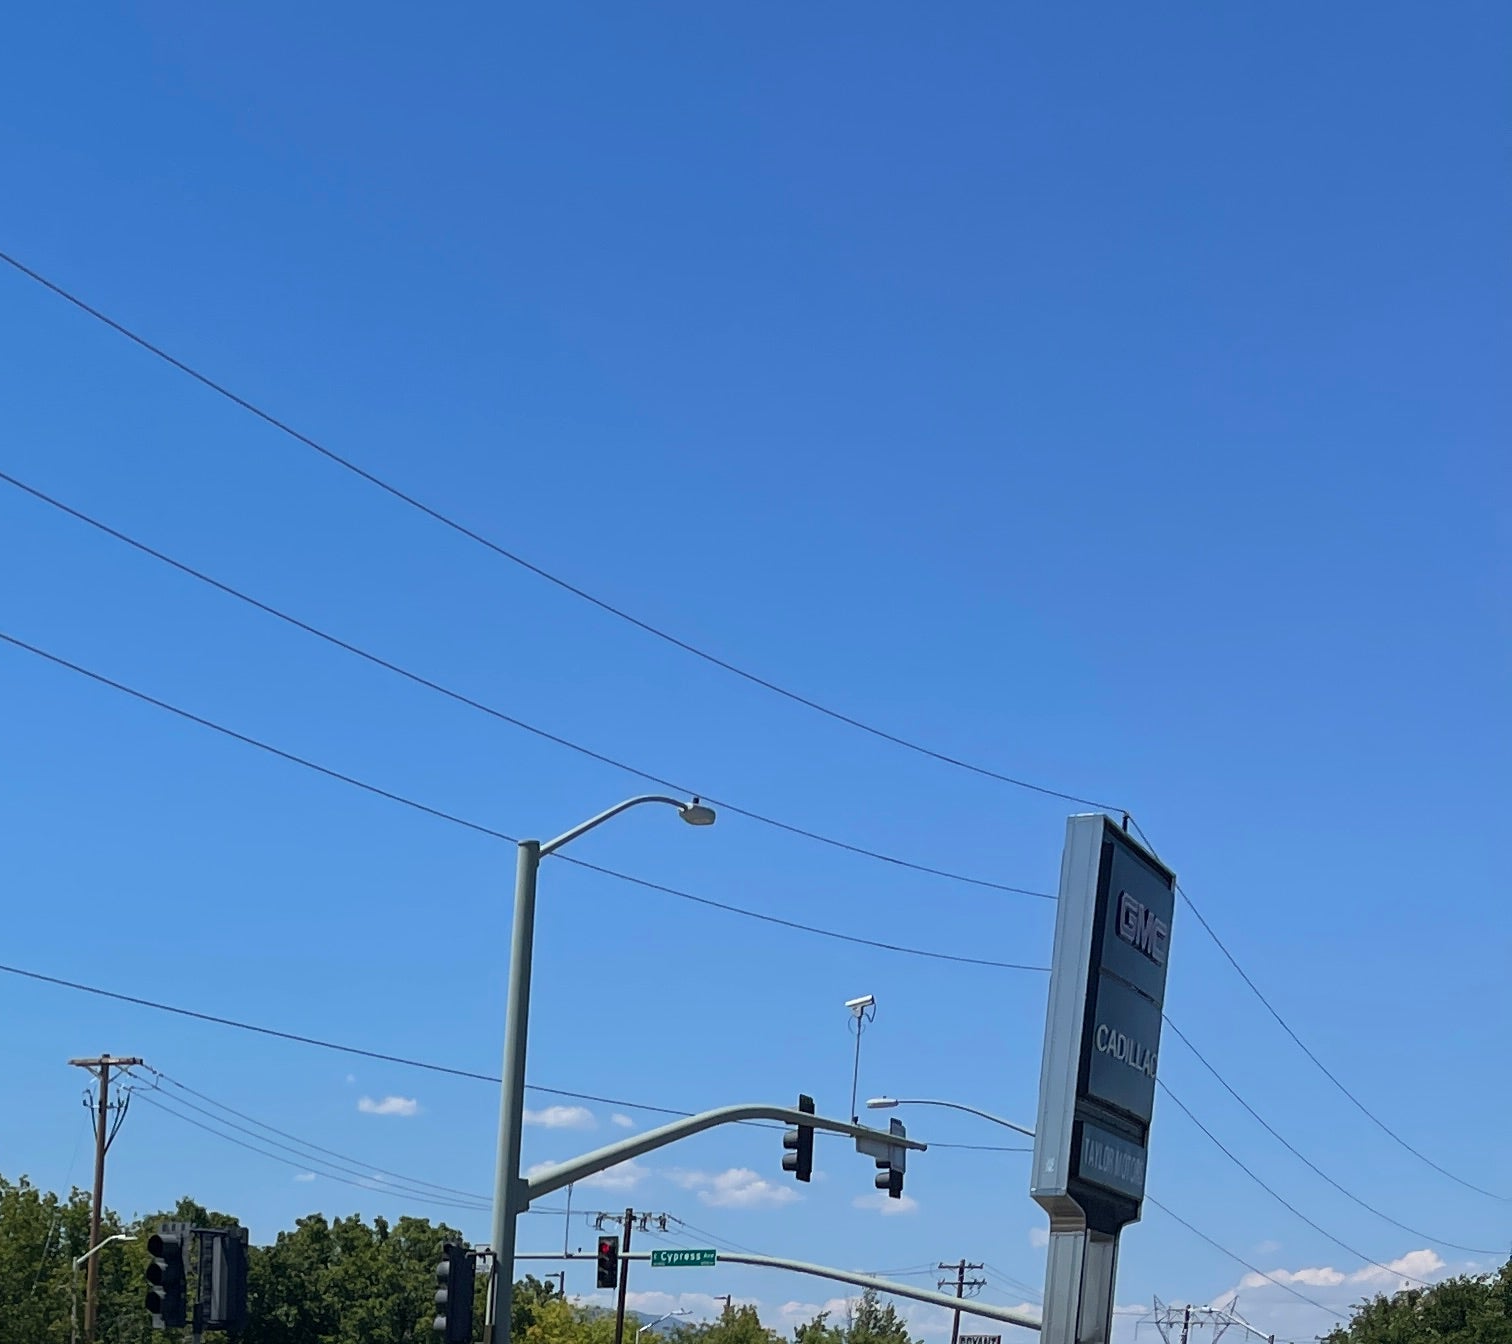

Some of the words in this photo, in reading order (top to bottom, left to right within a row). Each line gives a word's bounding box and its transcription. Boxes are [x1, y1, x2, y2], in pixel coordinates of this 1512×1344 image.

[1117, 891, 1167, 965] GMC
[1096, 1023, 1158, 1079] CADILLAC
[1084, 1138, 1115, 1176] TAYLOR
[661, 1251, 701, 1263] Cypress
